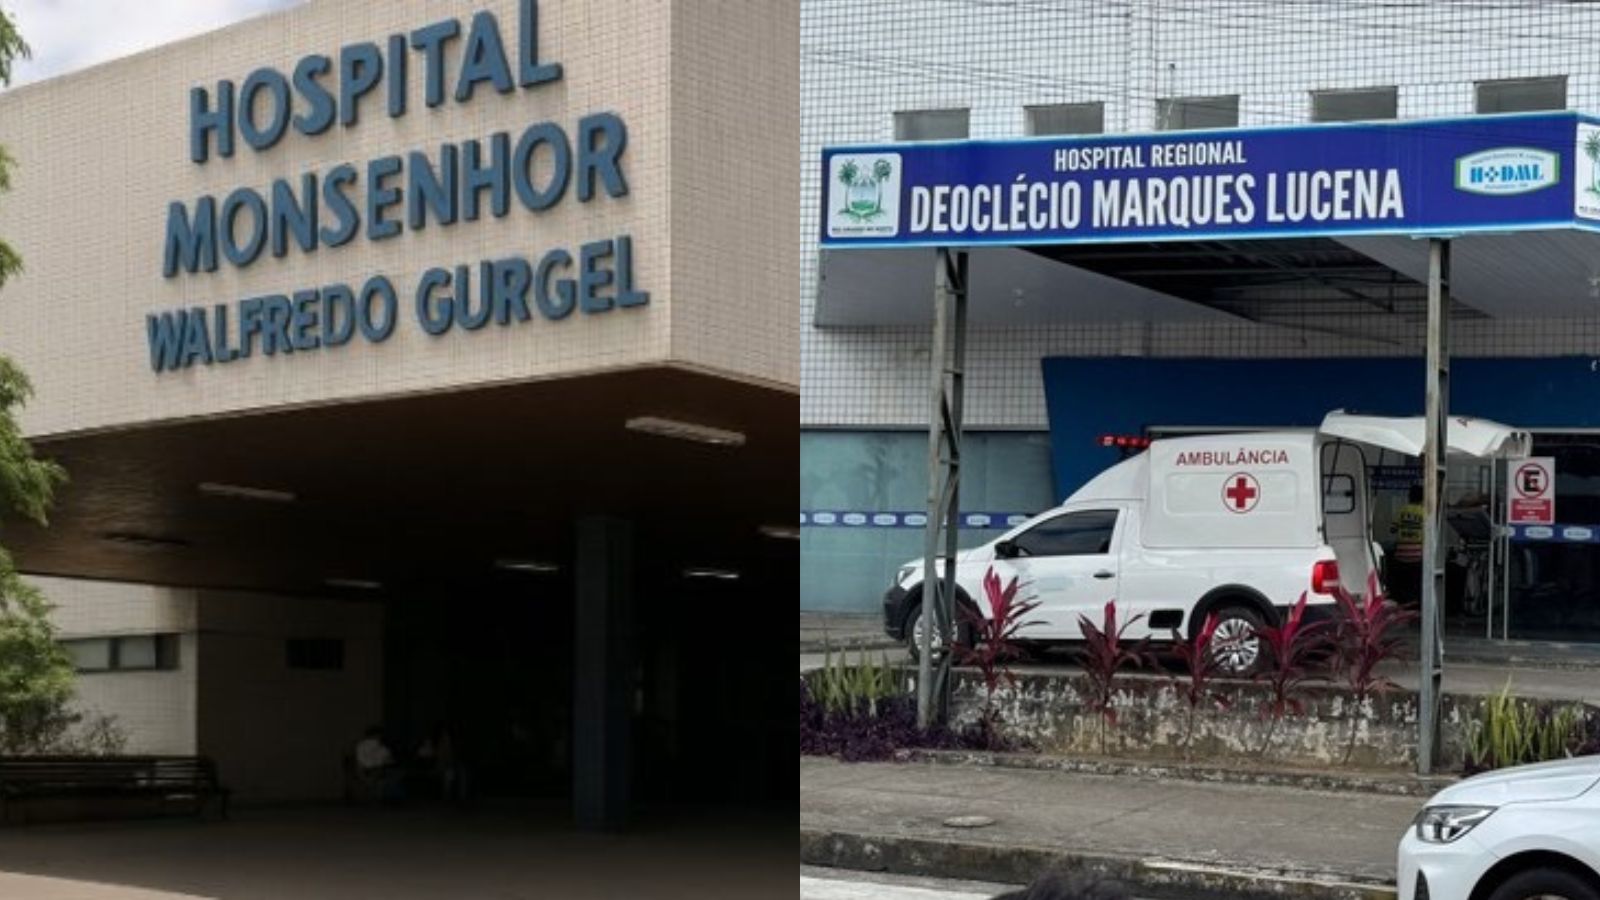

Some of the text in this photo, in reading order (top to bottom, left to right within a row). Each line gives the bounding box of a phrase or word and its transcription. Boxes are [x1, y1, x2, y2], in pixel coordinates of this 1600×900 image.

[189, 0, 564, 163] HOSPITAL
[162, 109, 629, 278] MONSENHOR
[910, 168, 1405, 233] DEOCLÉCIO MARQUES LUCENA
[1054, 140, 1247, 172] HOSPITAL REGIONAL
[146, 235, 650, 374] WALFREDO GURGEL
[1176, 447, 1290, 466] AMBULÂNCIA
